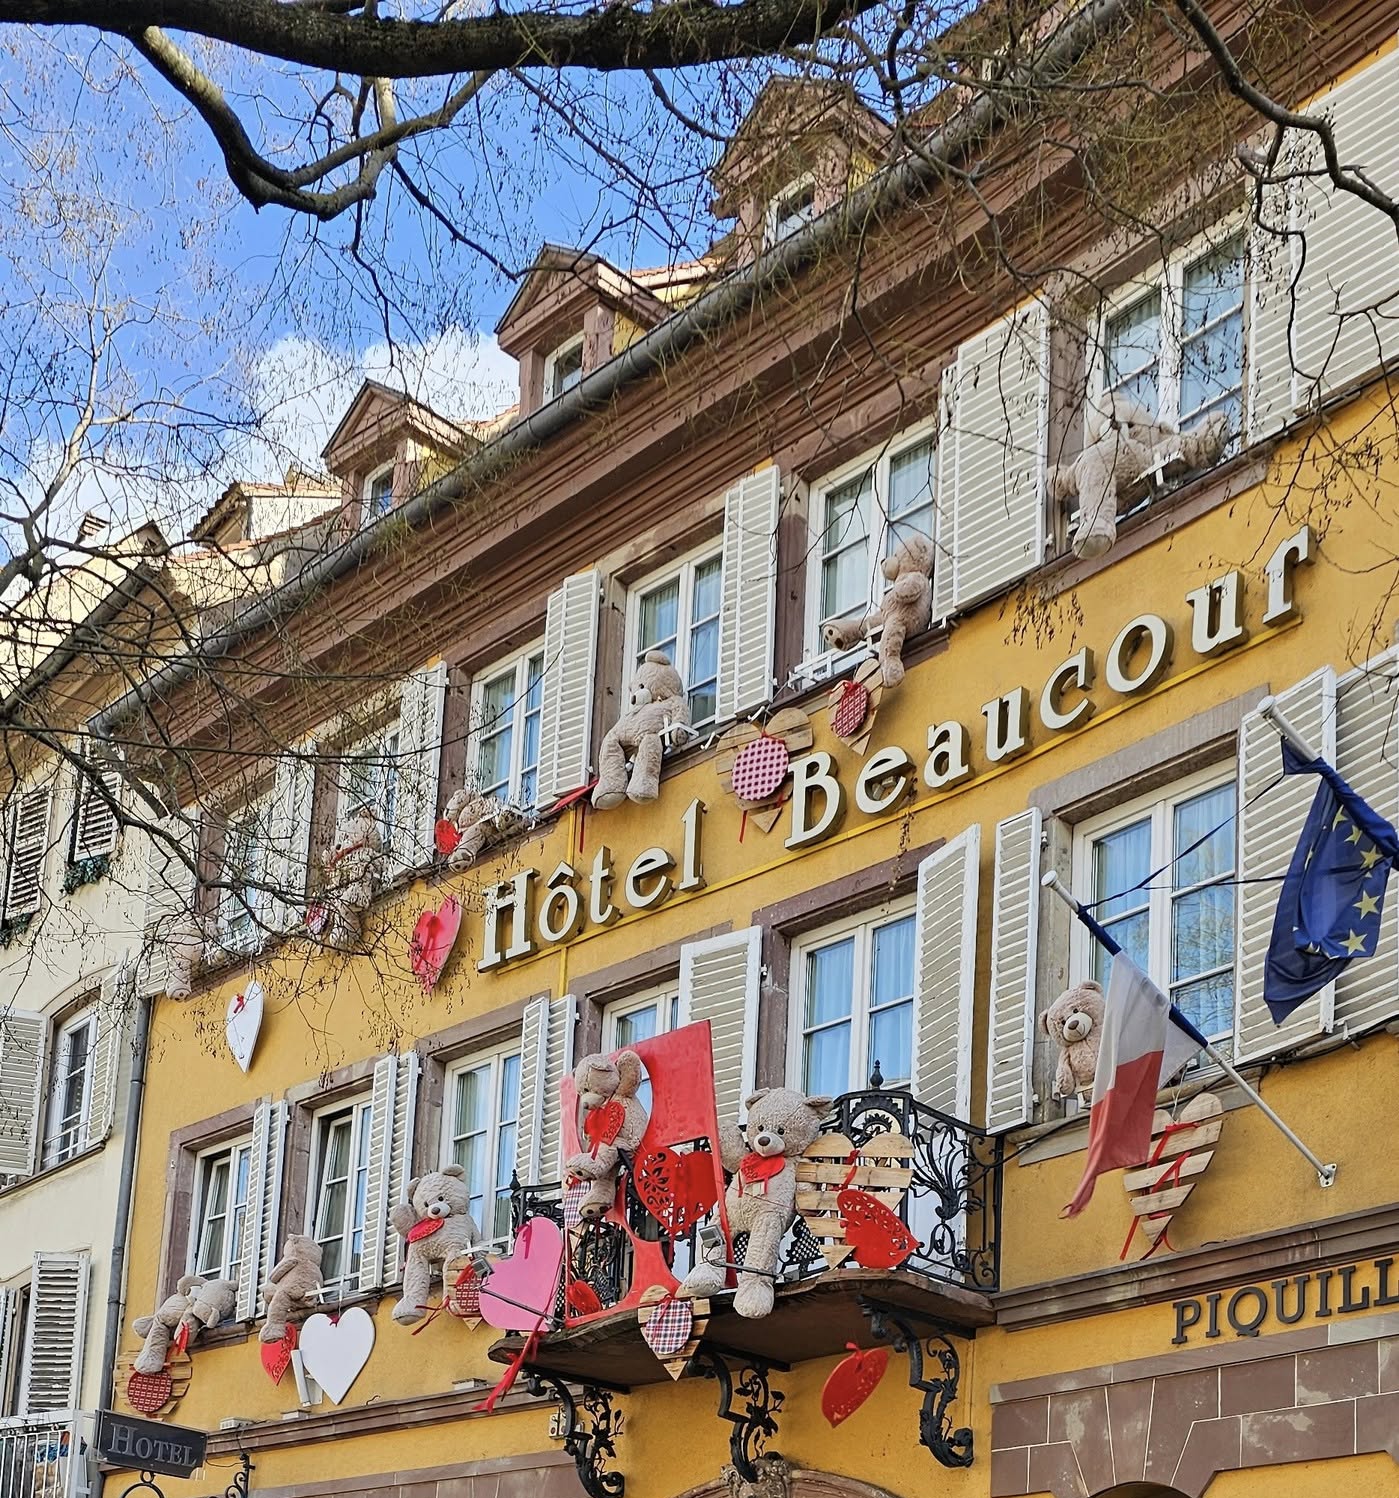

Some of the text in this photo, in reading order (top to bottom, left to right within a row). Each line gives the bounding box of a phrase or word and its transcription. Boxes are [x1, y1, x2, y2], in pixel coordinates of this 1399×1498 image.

[477, 525, 1318, 973] Hôtel Beaucour
[1171, 1257, 1399, 1345] PIQUILL
